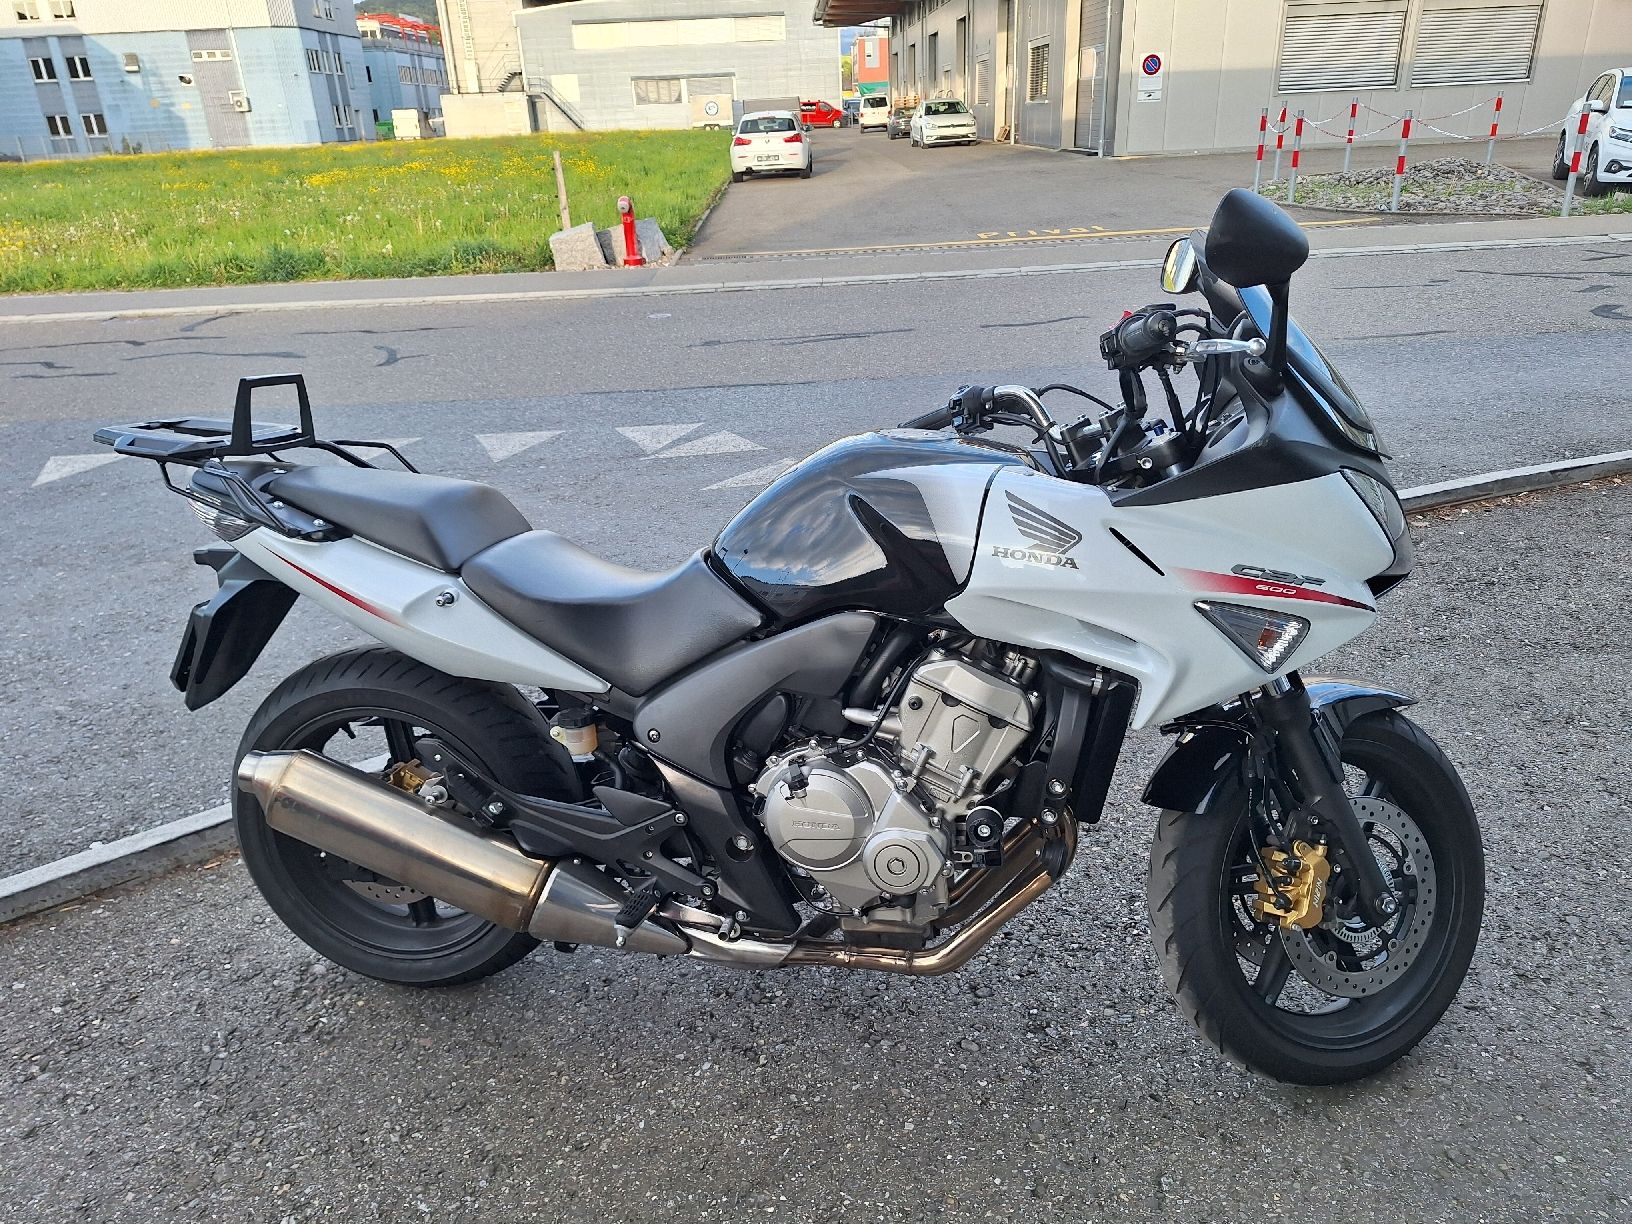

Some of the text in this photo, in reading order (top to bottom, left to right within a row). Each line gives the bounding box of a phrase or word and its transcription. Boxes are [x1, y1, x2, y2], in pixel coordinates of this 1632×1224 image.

[991, 545, 1080, 570] HONDA
[1230, 563, 1326, 586] CBF
[1255, 584, 1297, 595] 600
[791, 819, 841, 831] HONDA
